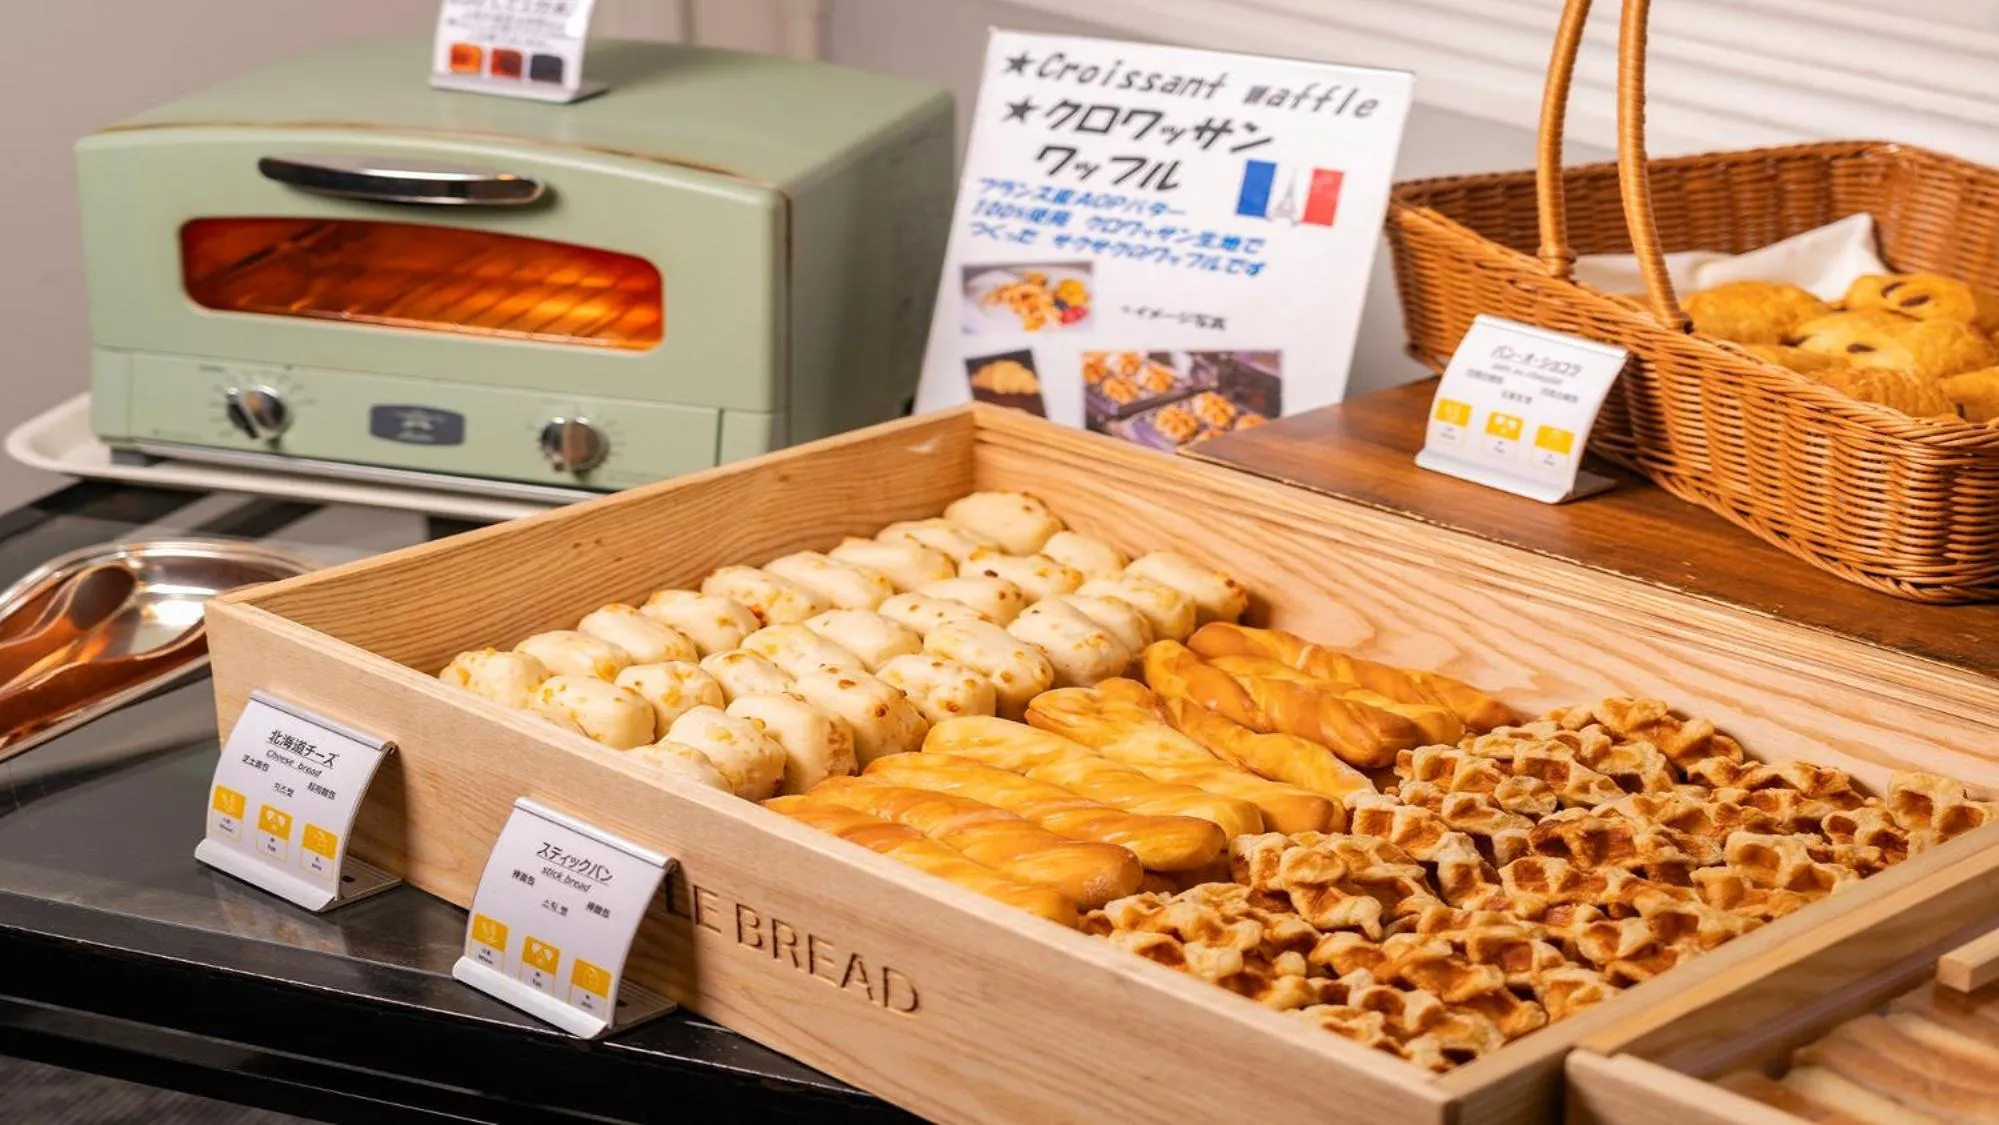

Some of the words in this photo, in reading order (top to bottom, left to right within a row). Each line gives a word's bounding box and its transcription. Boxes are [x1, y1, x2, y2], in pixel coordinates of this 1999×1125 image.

[1037, 53, 1227, 98] Croissant
[1044, 99, 1273, 153] クロワッサン
[1034, 145, 1181, 192] ワッフル
[267, 730, 340, 768] 北海道チーズ
[536, 841, 614, 882] スティックパン
[664, 874, 722, 936] LE
[735, 902, 918, 1018] BREAD
